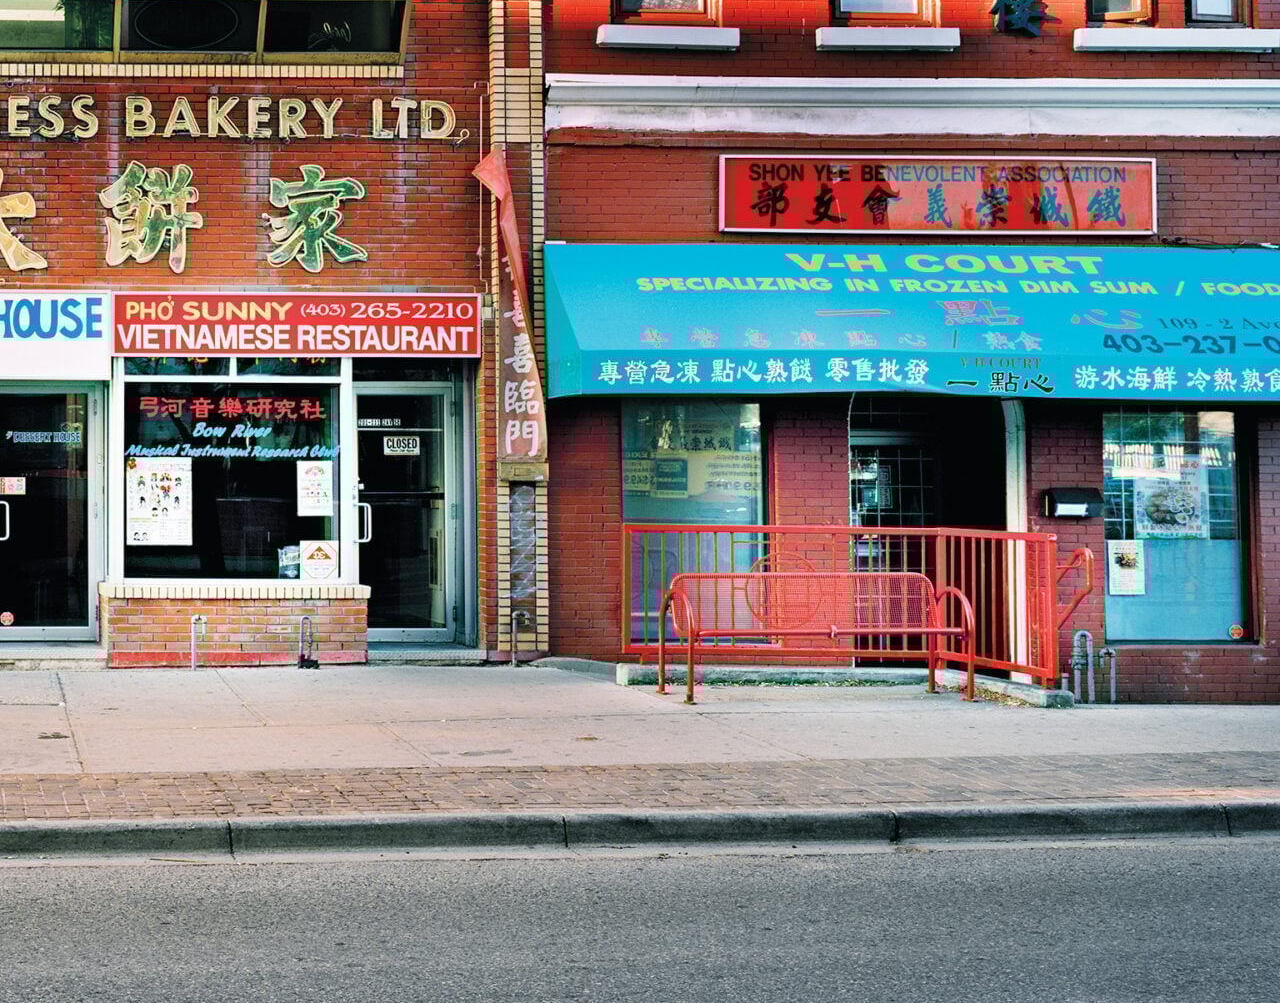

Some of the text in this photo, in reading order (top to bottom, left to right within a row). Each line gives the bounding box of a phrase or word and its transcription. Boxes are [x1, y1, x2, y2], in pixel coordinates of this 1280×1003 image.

[127, 95, 364, 140] BAKERY
[749, 163, 1127, 184] SHON YEE BENEVOLENT ASSOCIATION
[785, 253, 1104, 275] V-H COURT
[636, 277, 833, 292] SPECIALIZING
[845, 278, 880, 292] IN
[890, 278, 1008, 294] FROZEN
[1019, 280, 1080, 294] DIM
[1089, 281, 1159, 295] SUM
[183, 301, 293, 321] SUNNY
[300, 303, 346, 318] (403)
[350, 301, 474, 319] 265-2210
[1158, 318, 1198, 329] 109
[1218, 318, 1233, 329] 2
[117, 323, 474, 352] VIETNAMESE RESTAURANT
[598, 358, 701, 386] 專營急凍
[825, 358, 929, 386] 零售批發
[990, 357, 1041, 370] COURT
[947, 372, 1054, 393] 一點心
[1075, 366, 1178, 393] 游水海鮮
[139, 397, 327, 419] 弓河音樂研究社
[13, 431, 52, 444] DESSERT
[53, 431, 81, 443] HOUSE
[192, 422, 272, 438] Bow River
[125, 444, 179, 458] Musical
[180, 444, 250, 458] Instrument
[251, 445, 308, 458] Research
[386, 437, 418, 449] CLOSED
